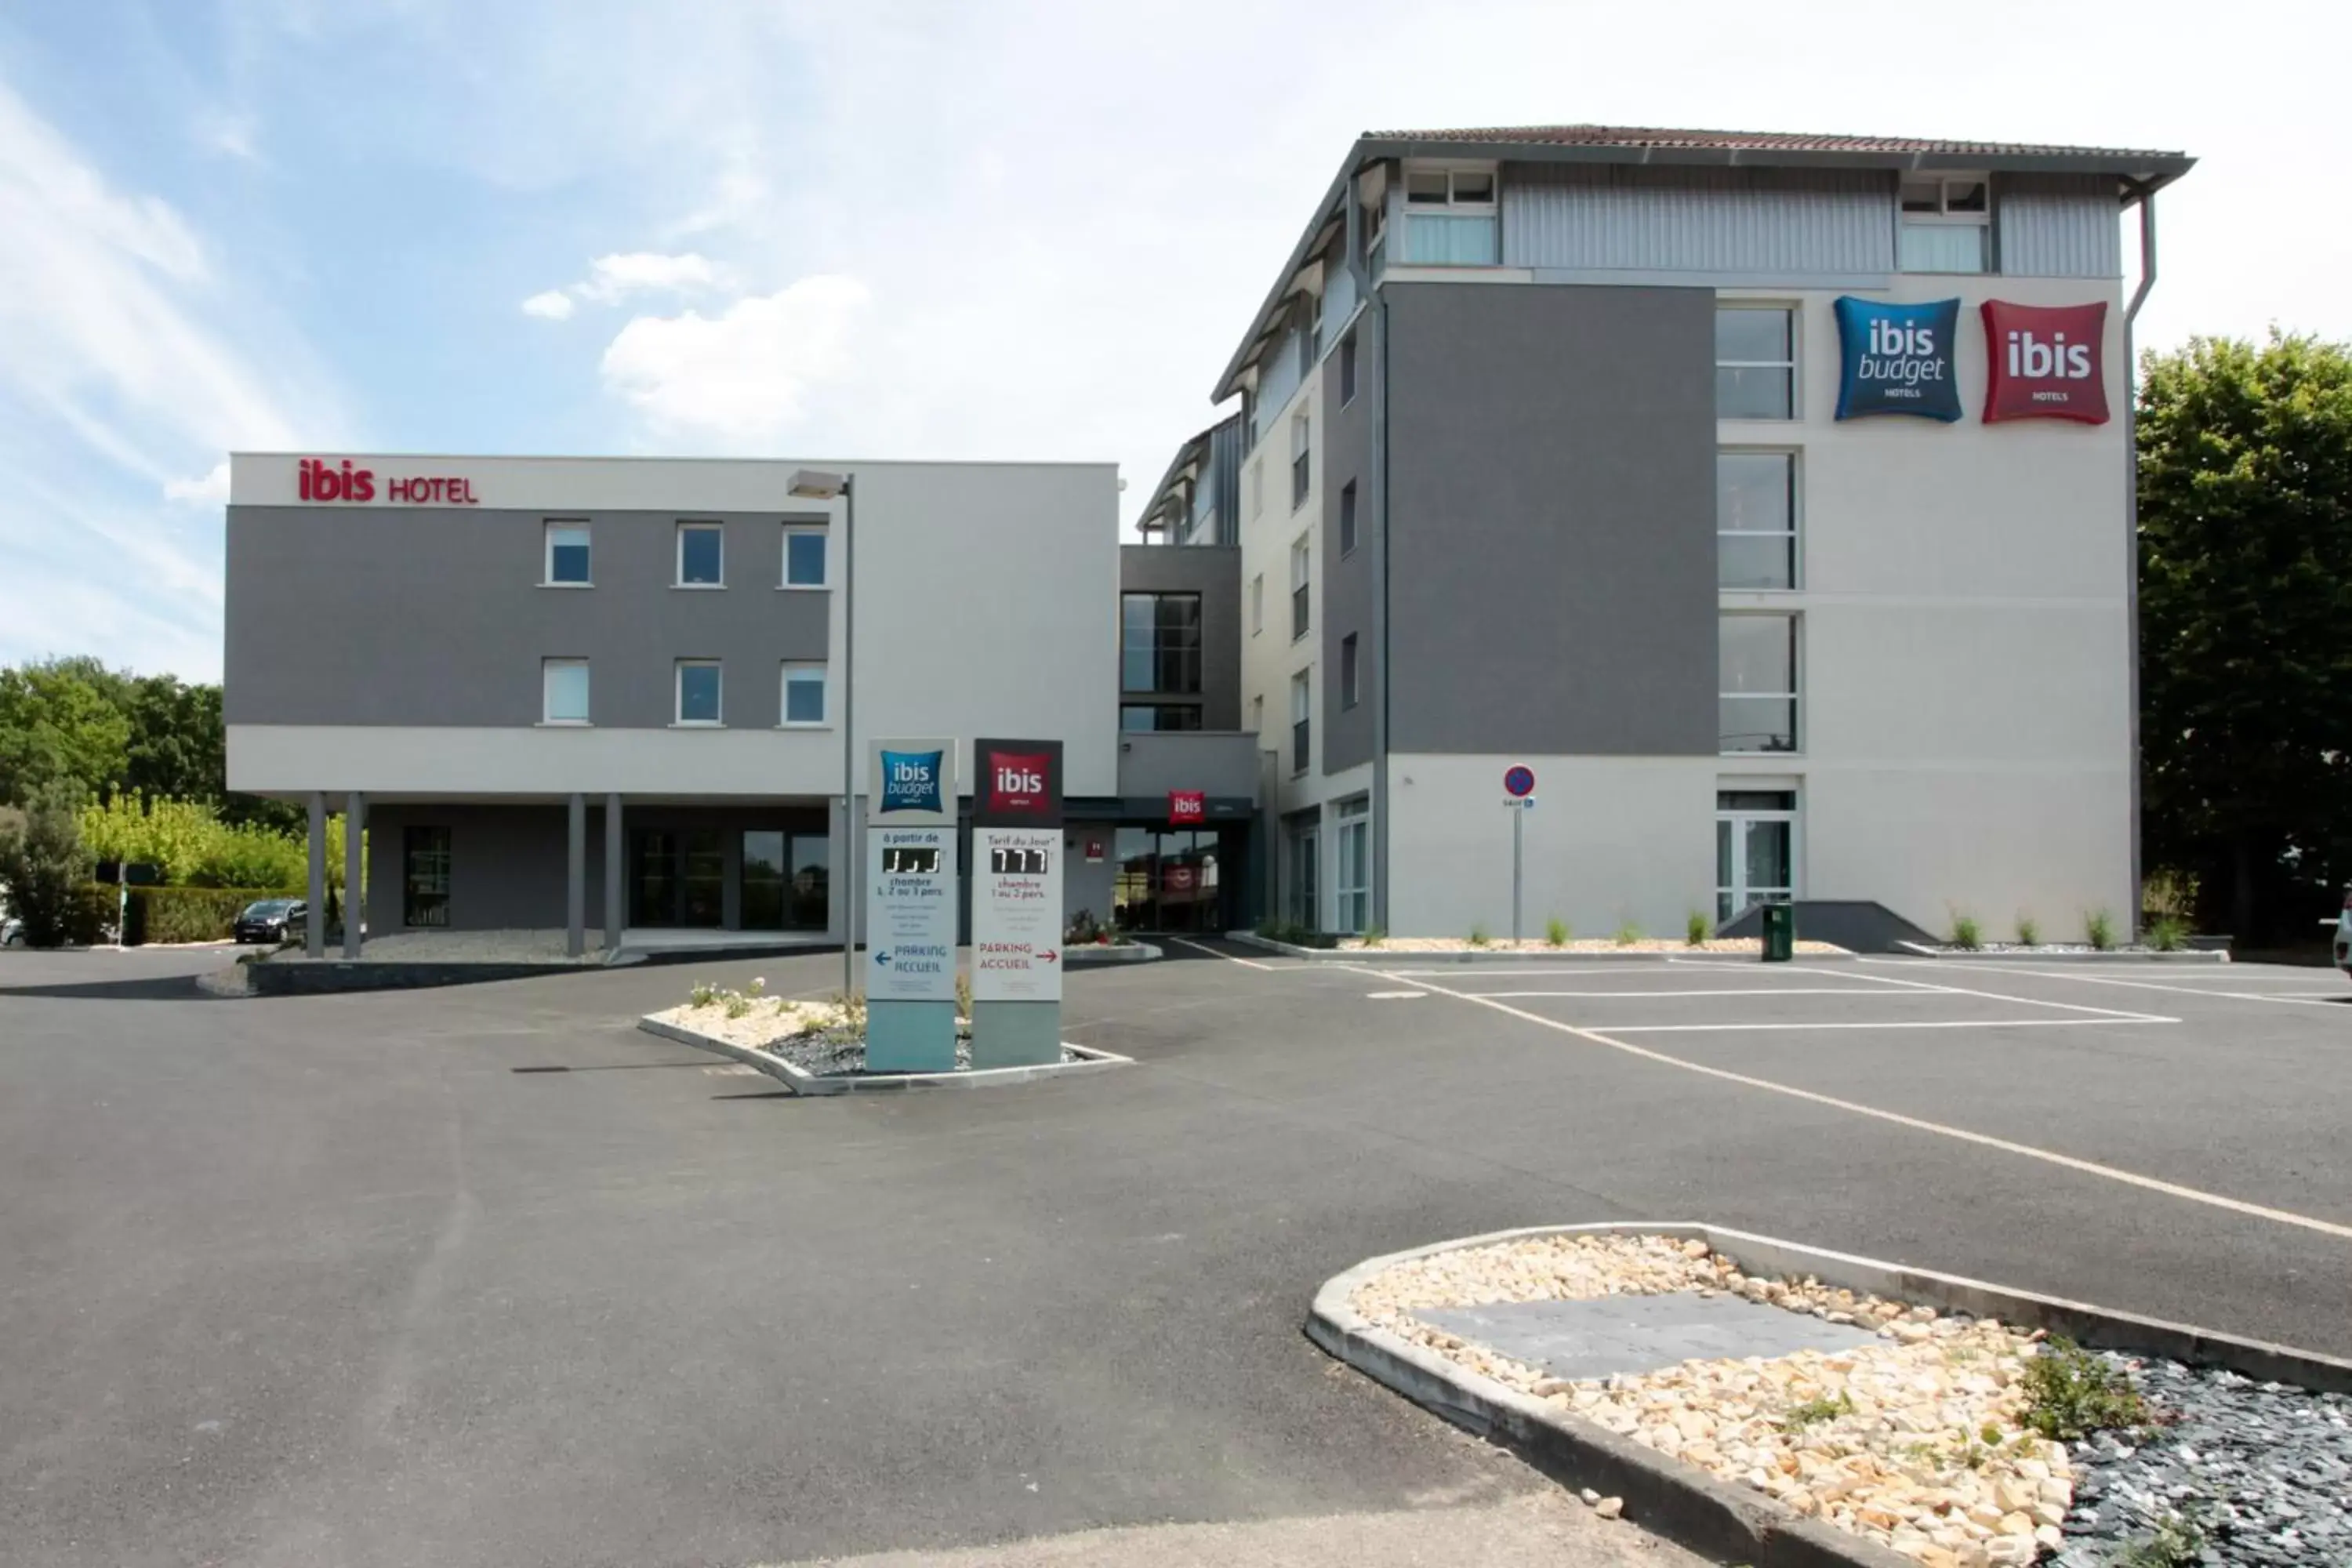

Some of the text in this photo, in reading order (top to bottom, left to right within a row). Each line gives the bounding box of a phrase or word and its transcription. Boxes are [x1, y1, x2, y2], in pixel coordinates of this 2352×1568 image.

[1869, 319, 1934, 356] ibis
[2007, 331, 2092, 379] ibis
[1858, 354, 1945, 385] budget
[1884, 388, 1921, 397] HOTELS
[2032, 391, 2069, 401] HOTELS
[299, 459, 479, 503] ibis HOTEL
[894, 762, 929, 782] ibis
[997, 768, 1042, 793] ibis
[887, 781, 935, 797] budget
[1174, 797, 1201, 814] ibis
[893, 833, 923, 844] partir
[925, 833, 939, 843] de
[989, 835, 1010, 846] Tarif
[1013, 835, 1026, 845] du
[890, 877, 932, 887] chambre
[998, 877, 1041, 888] chambre
[895, 945, 947, 957] PARKING
[979, 943, 1033, 954] PARKING
[895, 961, 942, 973] ACCUEIL
[979, 958, 1031, 970] ACCUEIL
